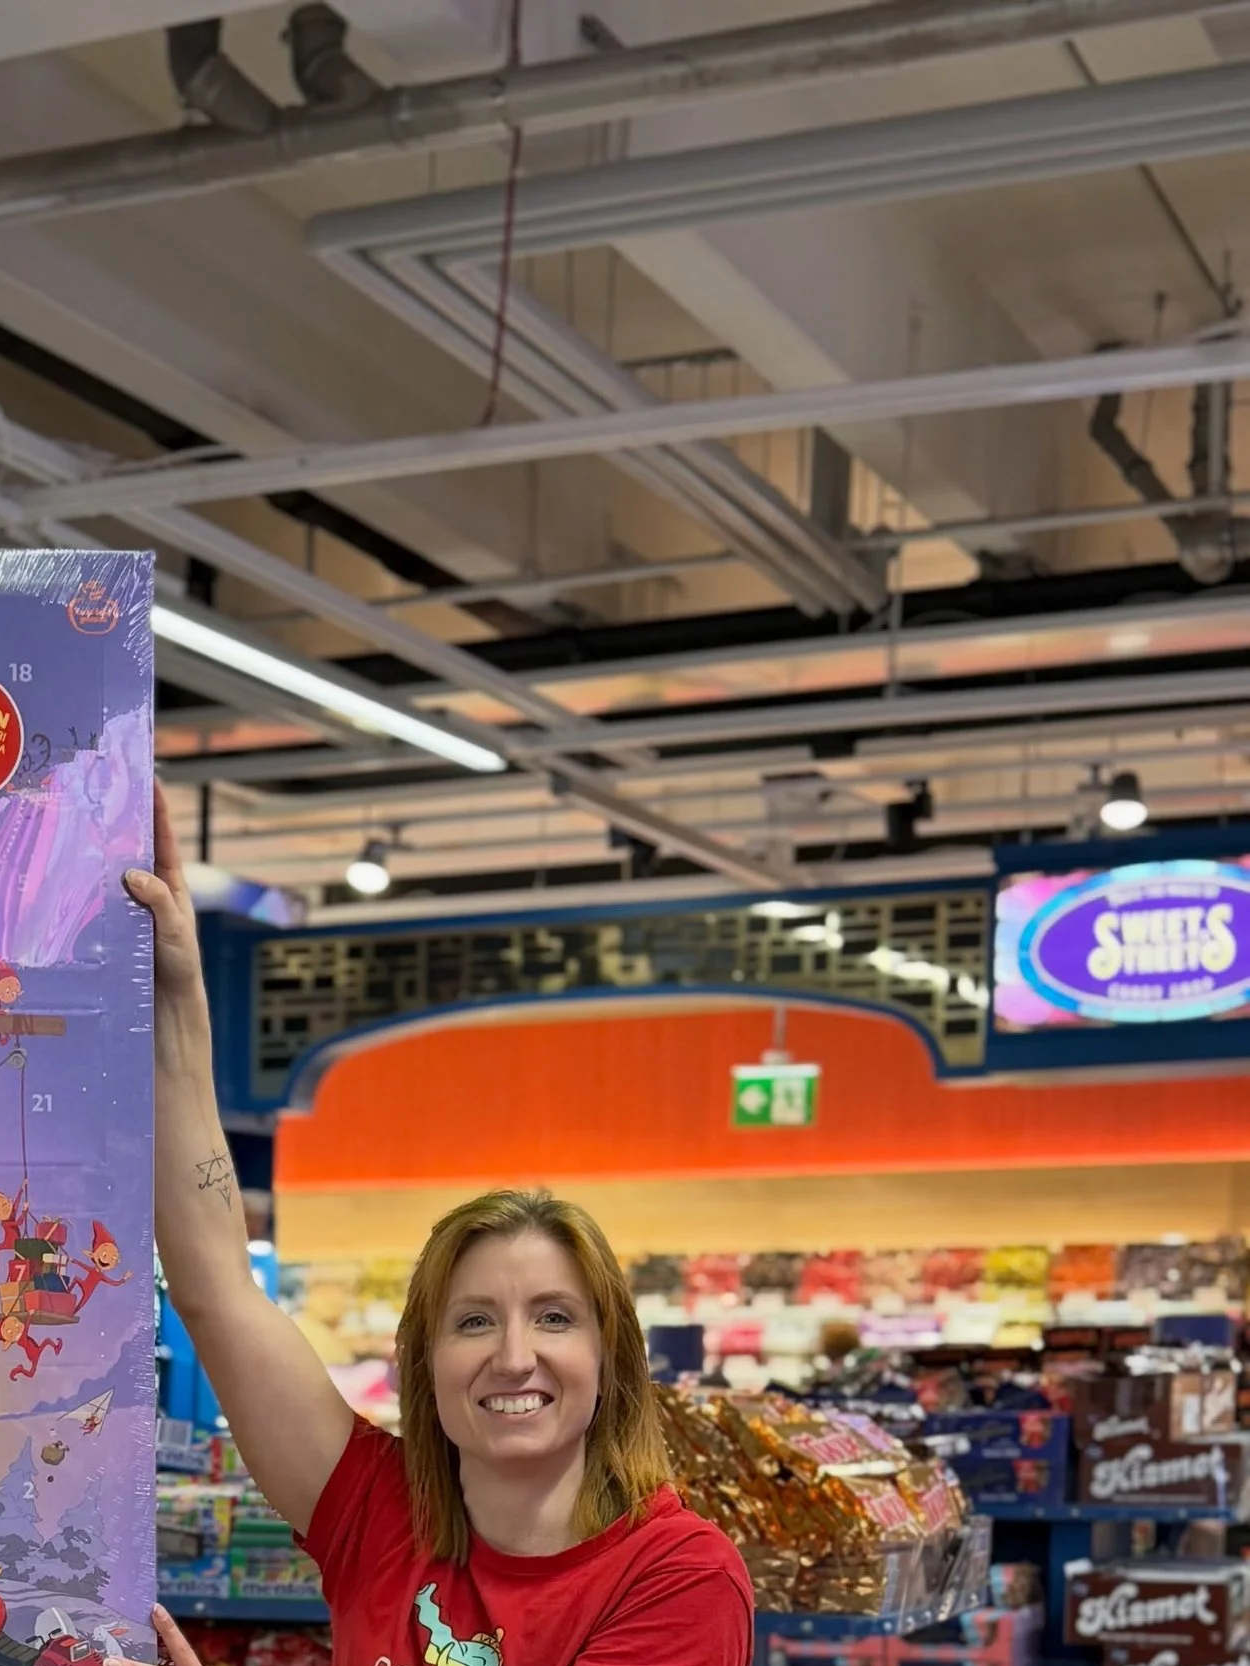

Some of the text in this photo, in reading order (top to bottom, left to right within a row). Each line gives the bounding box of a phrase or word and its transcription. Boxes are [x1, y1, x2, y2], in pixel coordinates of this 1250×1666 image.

[9, 664, 32, 682] 18
[17, 874, 29, 892] 5
[32, 1095, 53, 1112] 21
[15, 1265, 26, 1282] 7
[23, 1481, 35, 1499] 2
